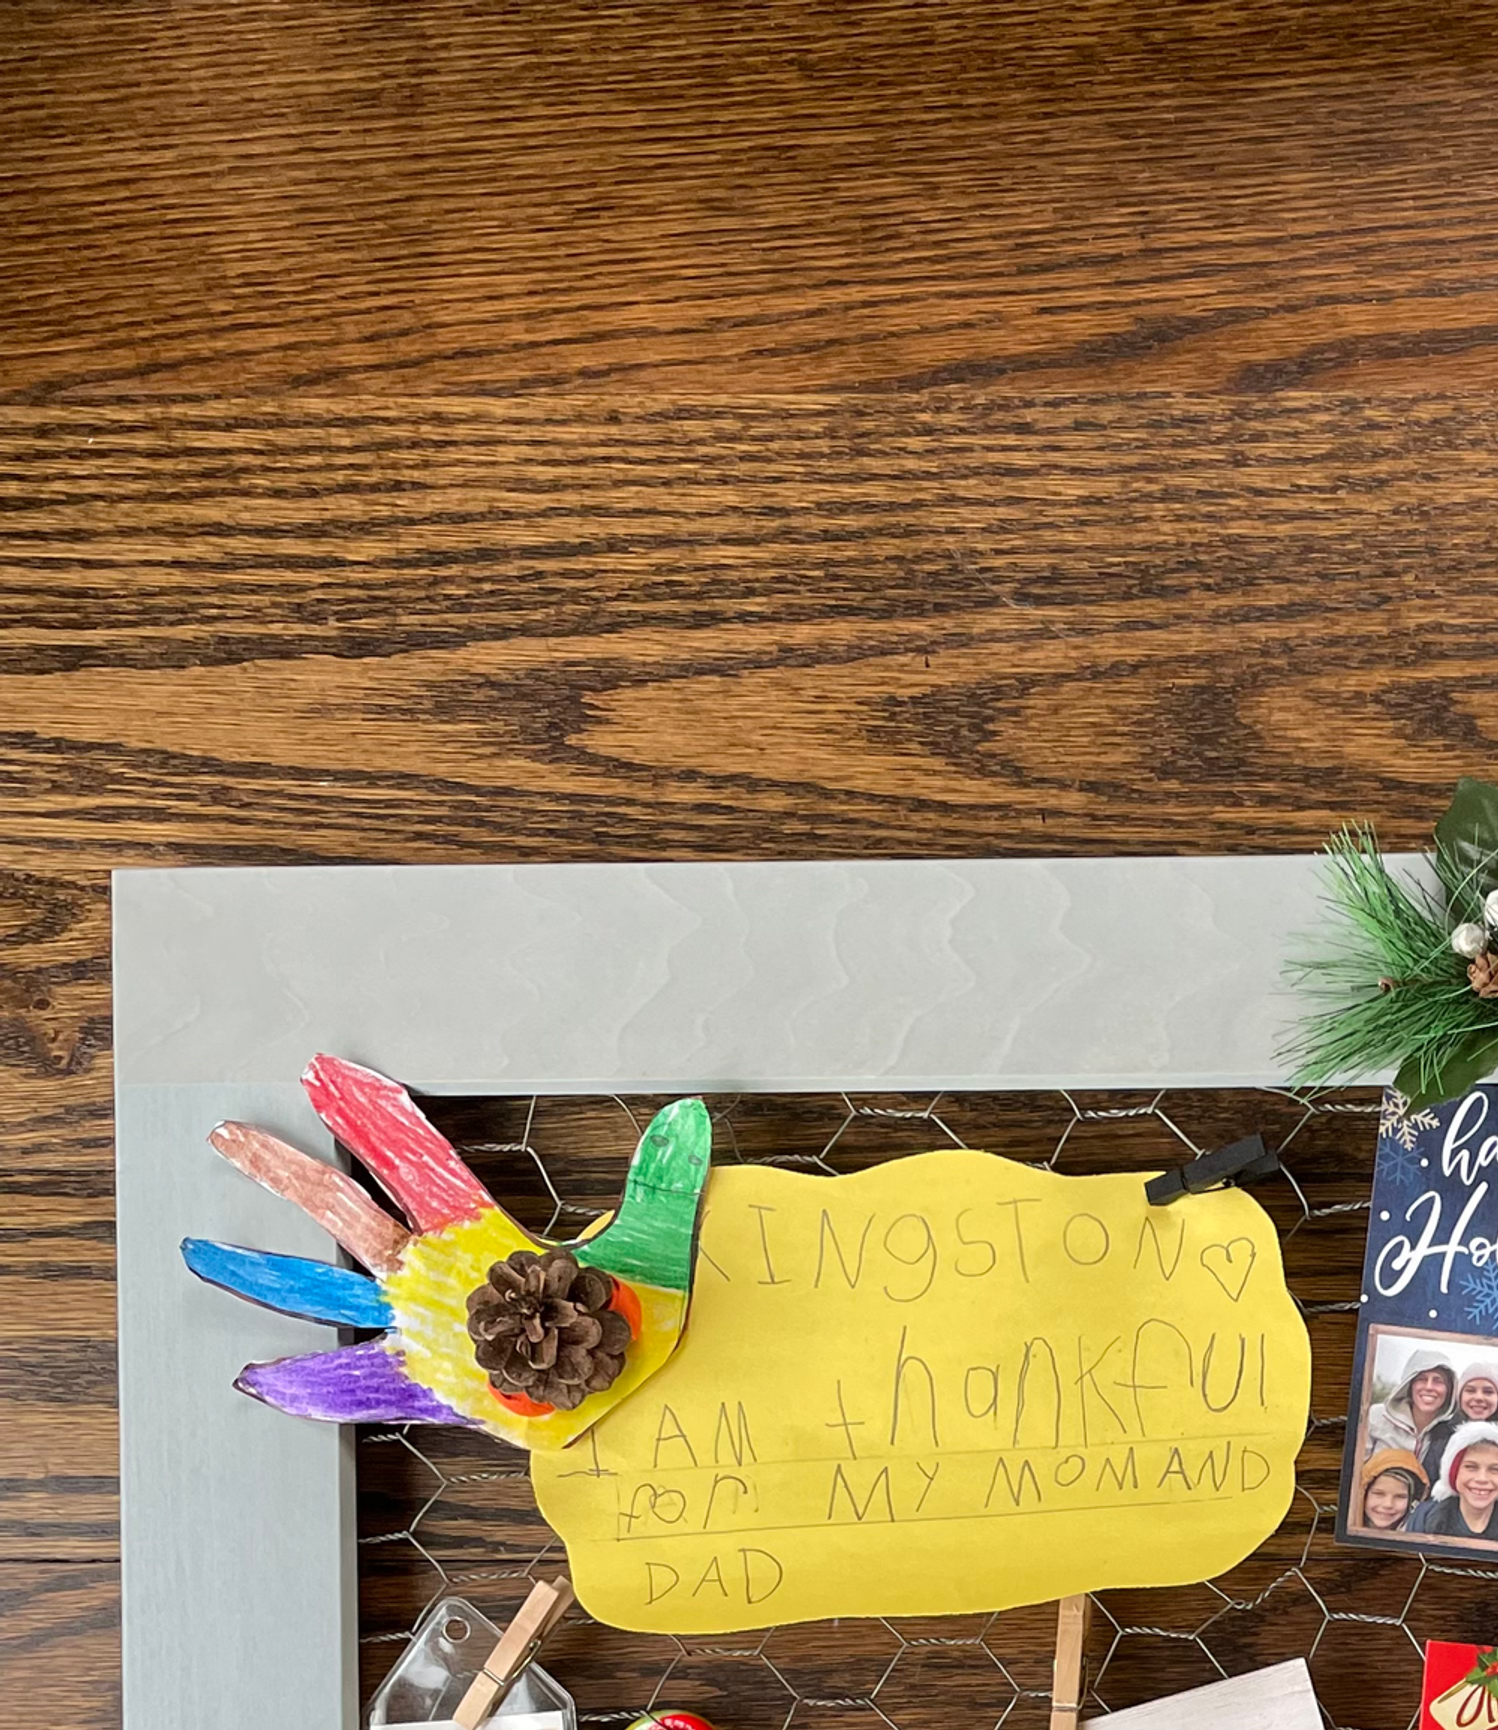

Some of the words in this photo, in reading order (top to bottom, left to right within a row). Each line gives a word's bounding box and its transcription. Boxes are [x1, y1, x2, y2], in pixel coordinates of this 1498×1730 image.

[653, 1401, 758, 1467] AM
[828, 1461, 939, 1523] MY
[644, 1548, 783, 1605] DAD
